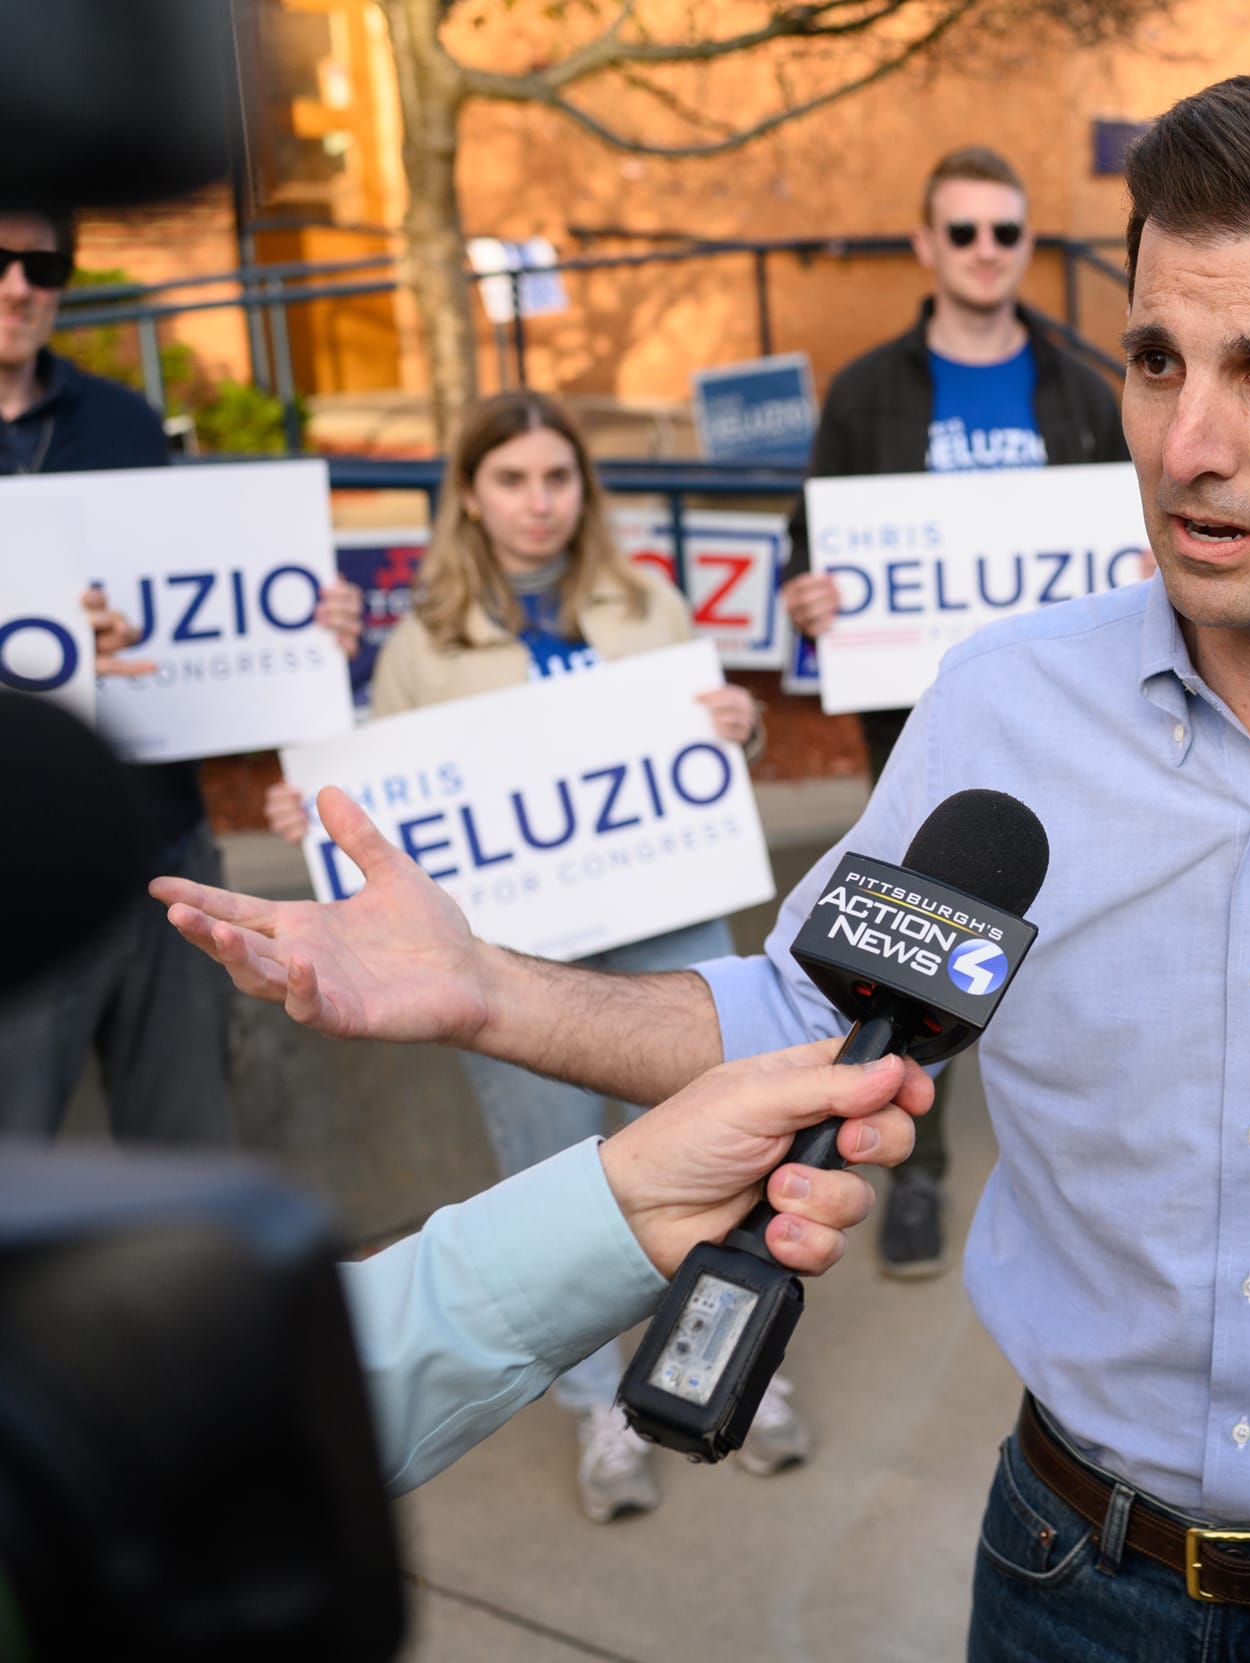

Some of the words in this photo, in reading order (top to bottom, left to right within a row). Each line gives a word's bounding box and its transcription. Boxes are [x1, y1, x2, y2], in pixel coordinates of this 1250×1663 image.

[818, 522, 944, 554] CHRIS
[557, 817, 743, 889] CONGRESS
[818, 885, 956, 952] ACTION
[845, 871, 1004, 942] PITTSBURGH'S
[827, 914, 942, 977] NEWS
